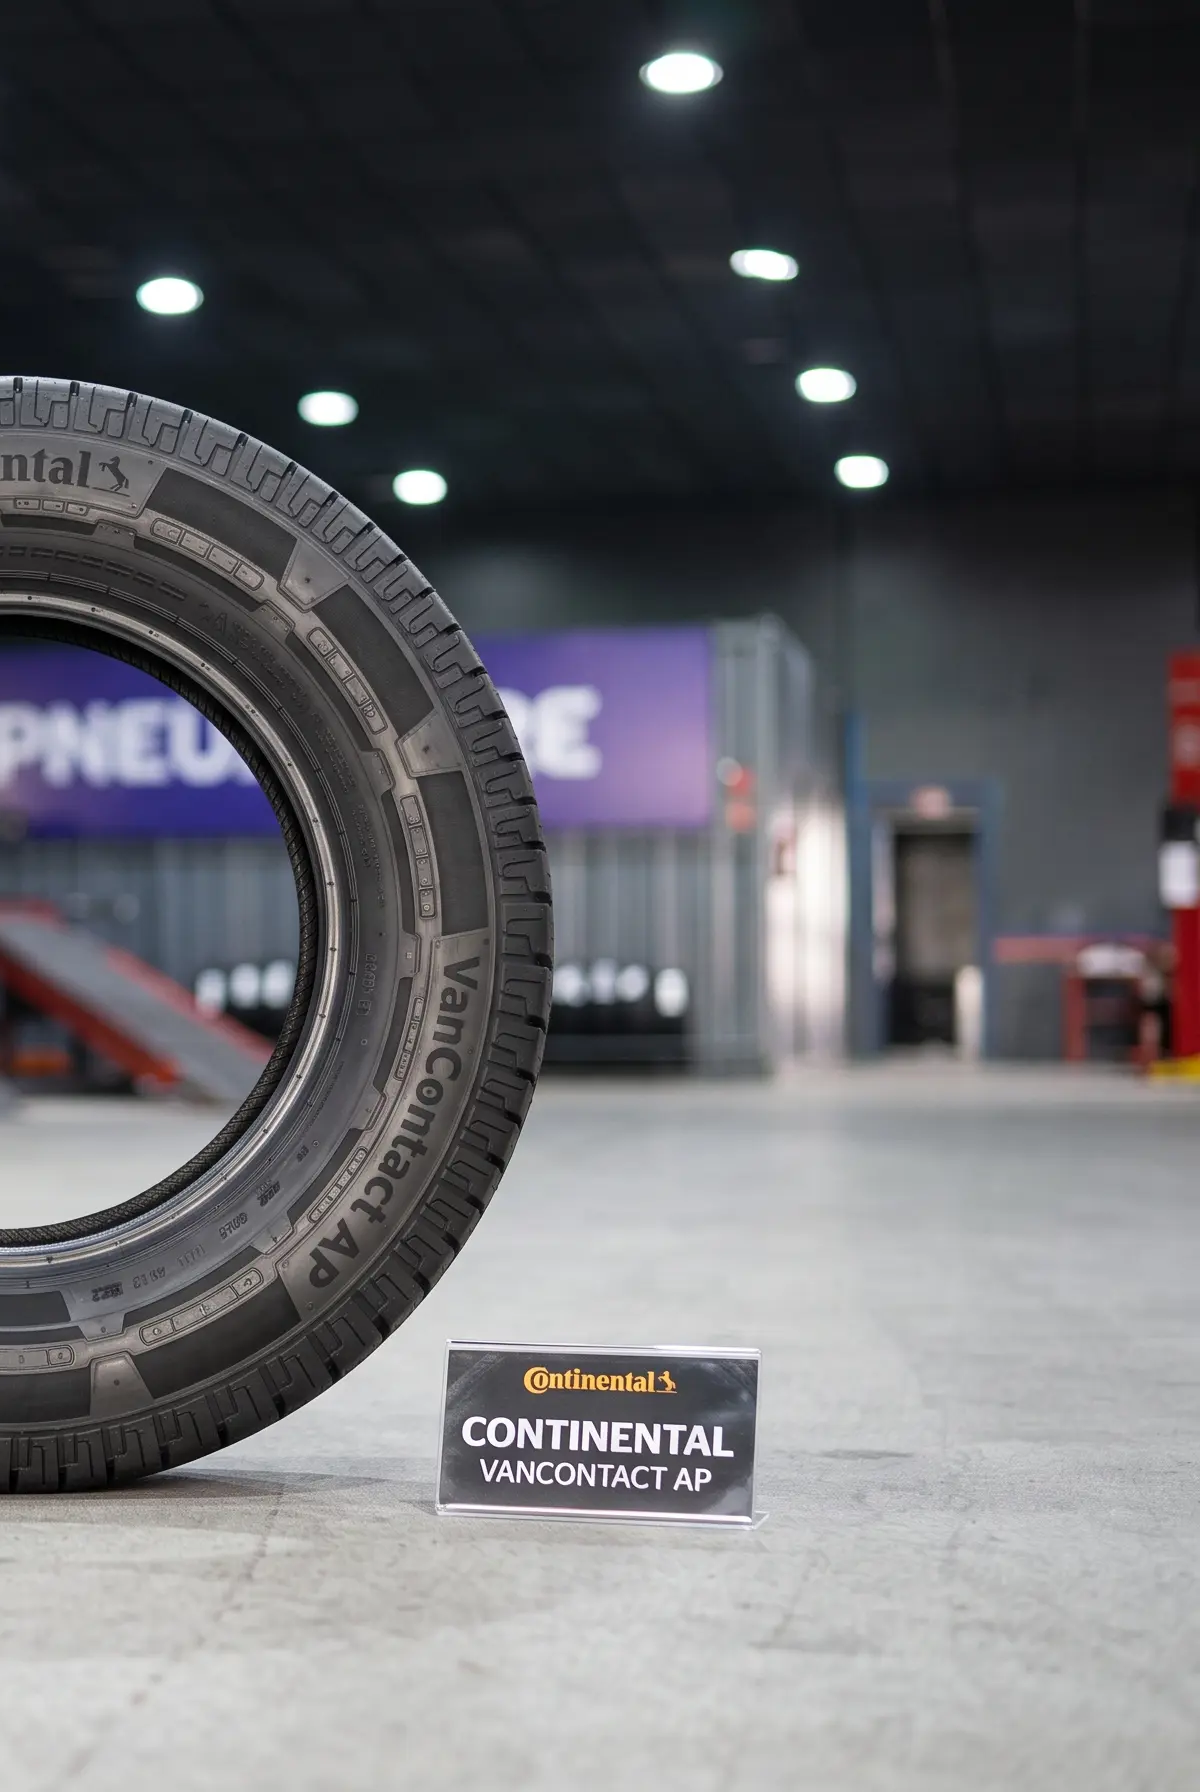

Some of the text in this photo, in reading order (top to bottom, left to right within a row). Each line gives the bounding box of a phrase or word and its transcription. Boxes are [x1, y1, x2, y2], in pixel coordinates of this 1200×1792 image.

[350, 956, 481, 1224] VanContact
[309, 1217, 360, 1289] AP
[523, 1366, 656, 1394] Continental
[461, 1416, 734, 1458] CONTINENTAL
[479, 1458, 712, 1492] VANCONTACT AP
